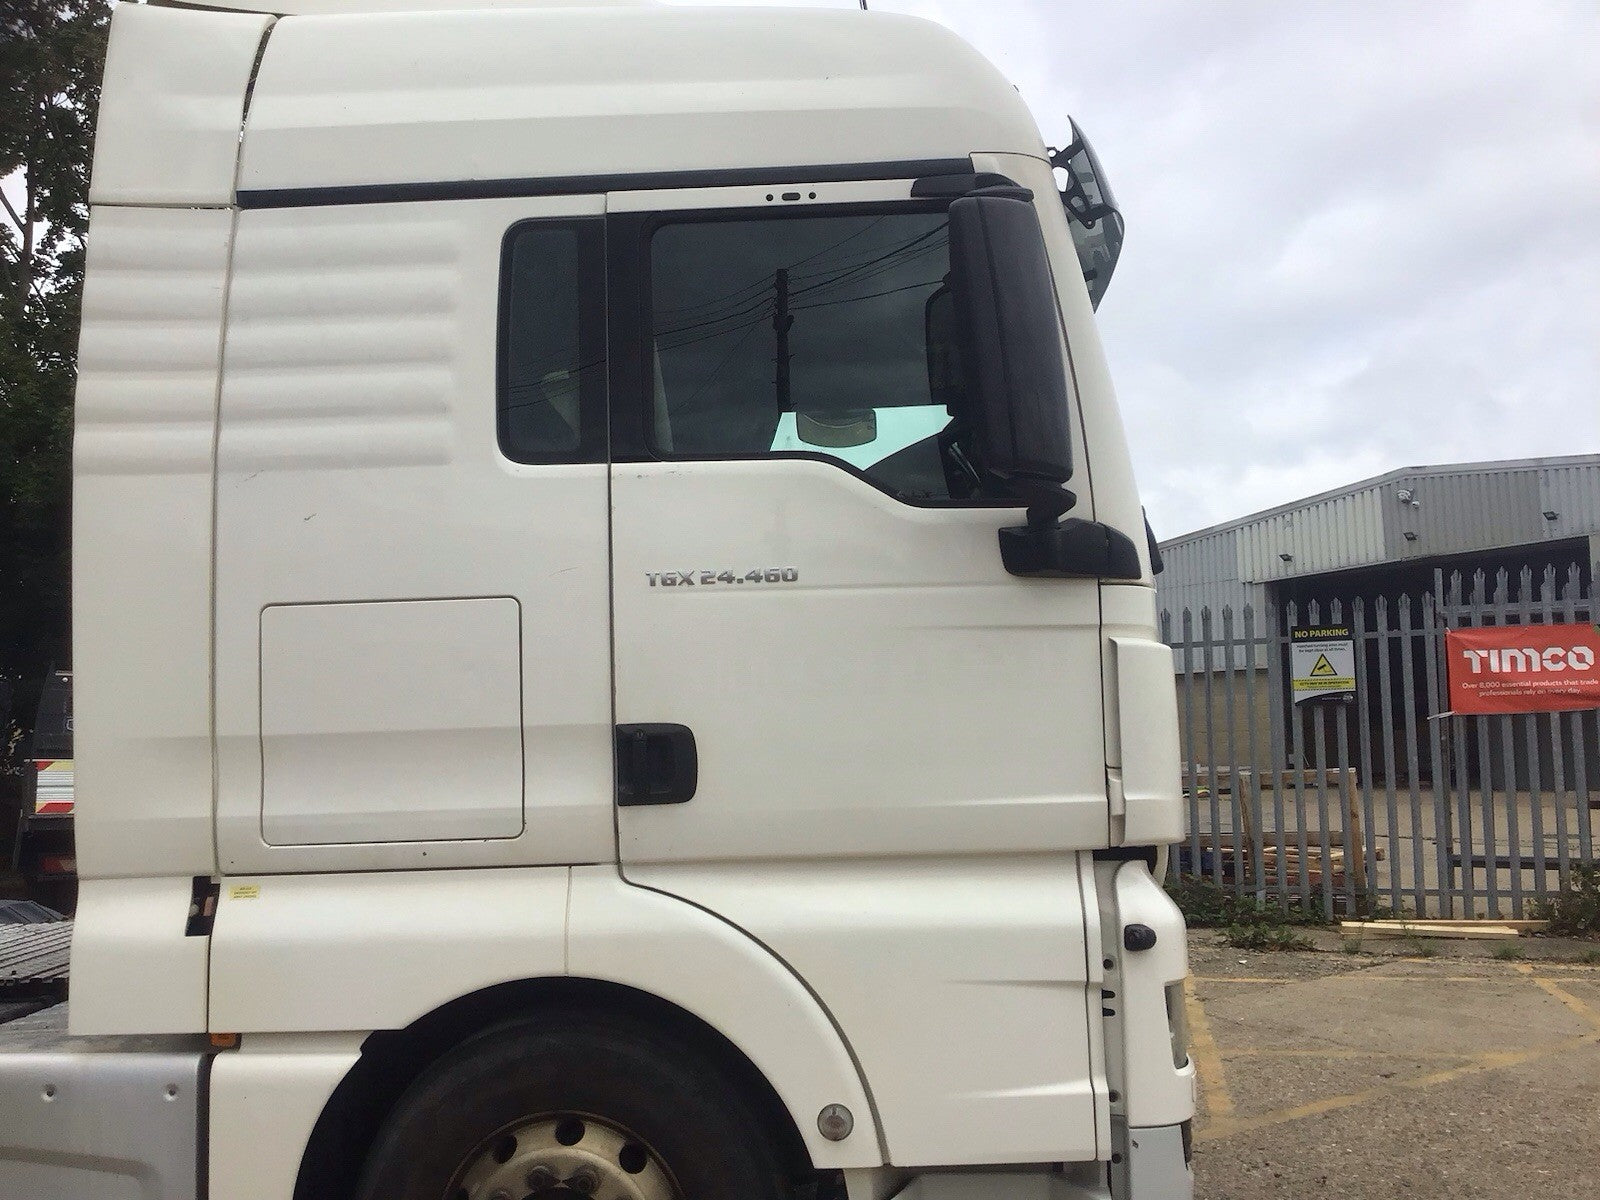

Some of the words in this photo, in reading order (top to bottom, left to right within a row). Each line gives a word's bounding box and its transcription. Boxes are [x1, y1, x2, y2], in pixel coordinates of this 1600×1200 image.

[645, 569, 695, 587] TGX
[700, 567, 799, 585] 24.460
[1294, 630, 1308, 638] NO
[1309, 629, 1349, 637] PARKING
[1463, 646, 1595, 674] TIMCO
[1533, 680, 1562, 688] products
[1563, 678, 1579, 686] that
[1580, 678, 1599, 686] trade
